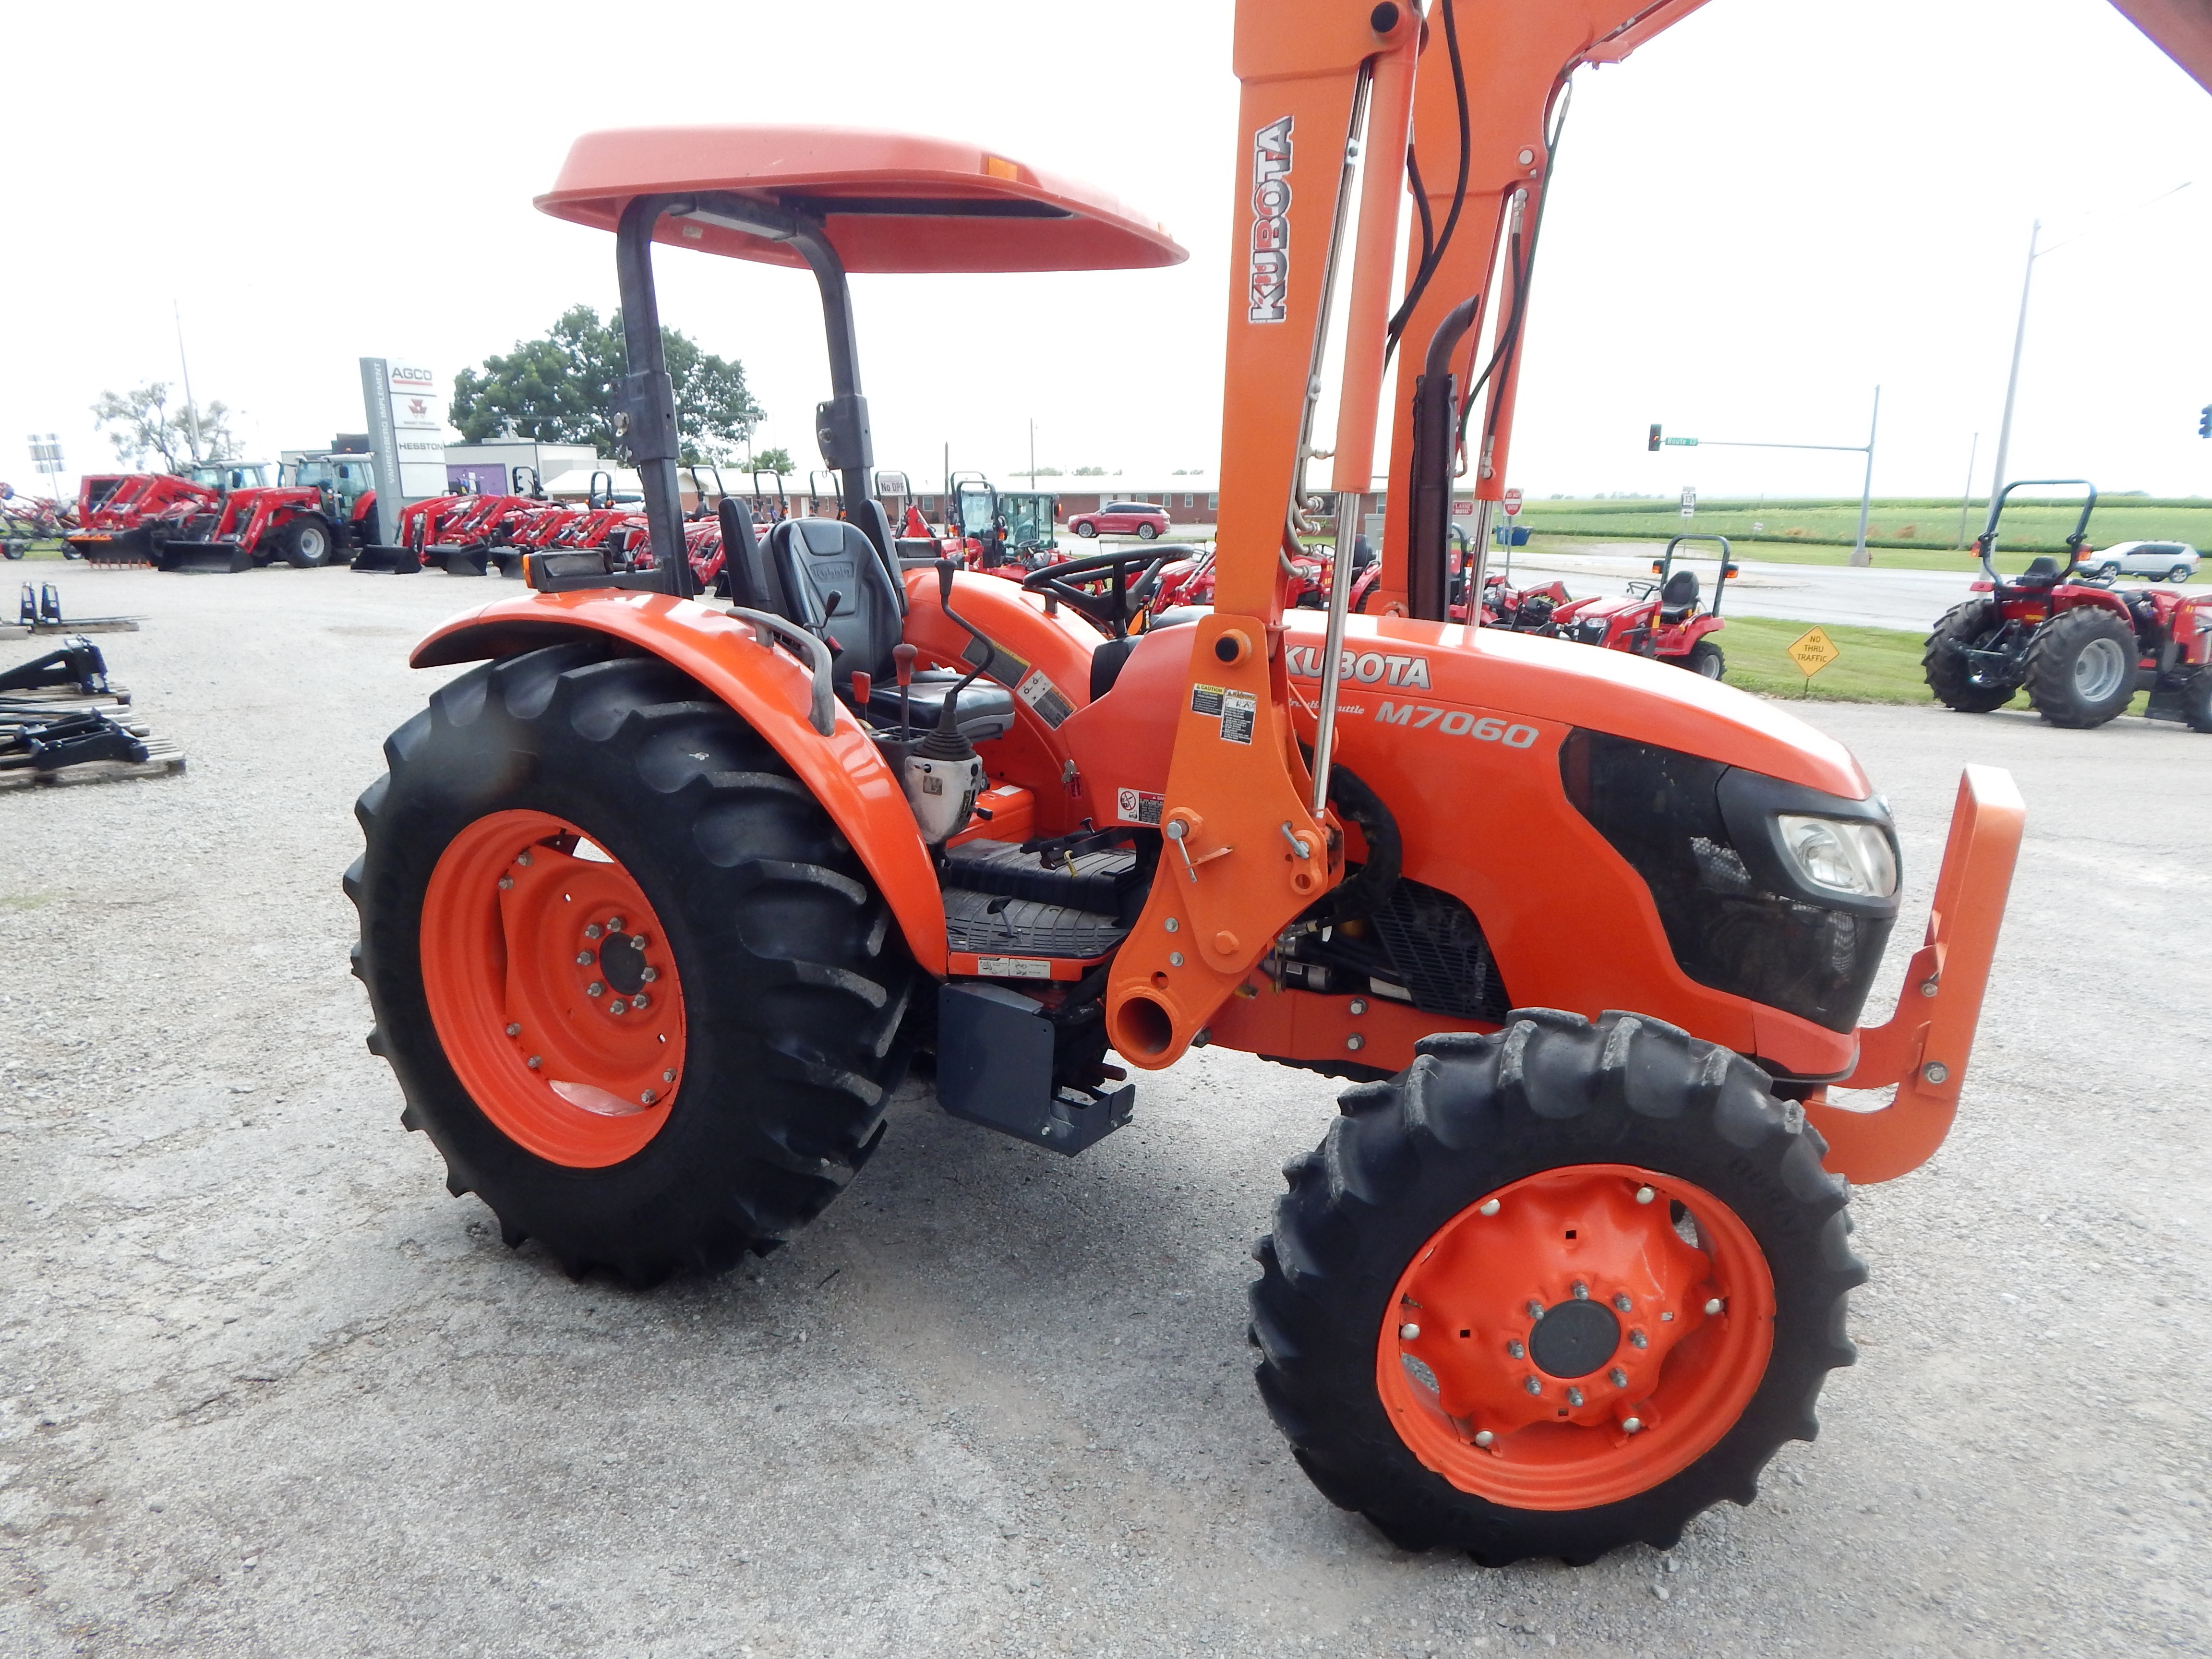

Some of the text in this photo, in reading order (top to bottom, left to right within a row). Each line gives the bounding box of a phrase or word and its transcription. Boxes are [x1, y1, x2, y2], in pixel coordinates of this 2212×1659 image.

[1249, 115, 1295, 323] KUBOTA
[392, 367, 432, 381] AGCO
[374, 362, 395, 484] VAHRENBERG IMPLEMENT
[881, 482, 904, 492] No DPF
[1804, 644, 1824, 652] THRU
[1797, 653, 1827, 662] TRAFFIC
[1374, 701, 1539, 749] M7060
